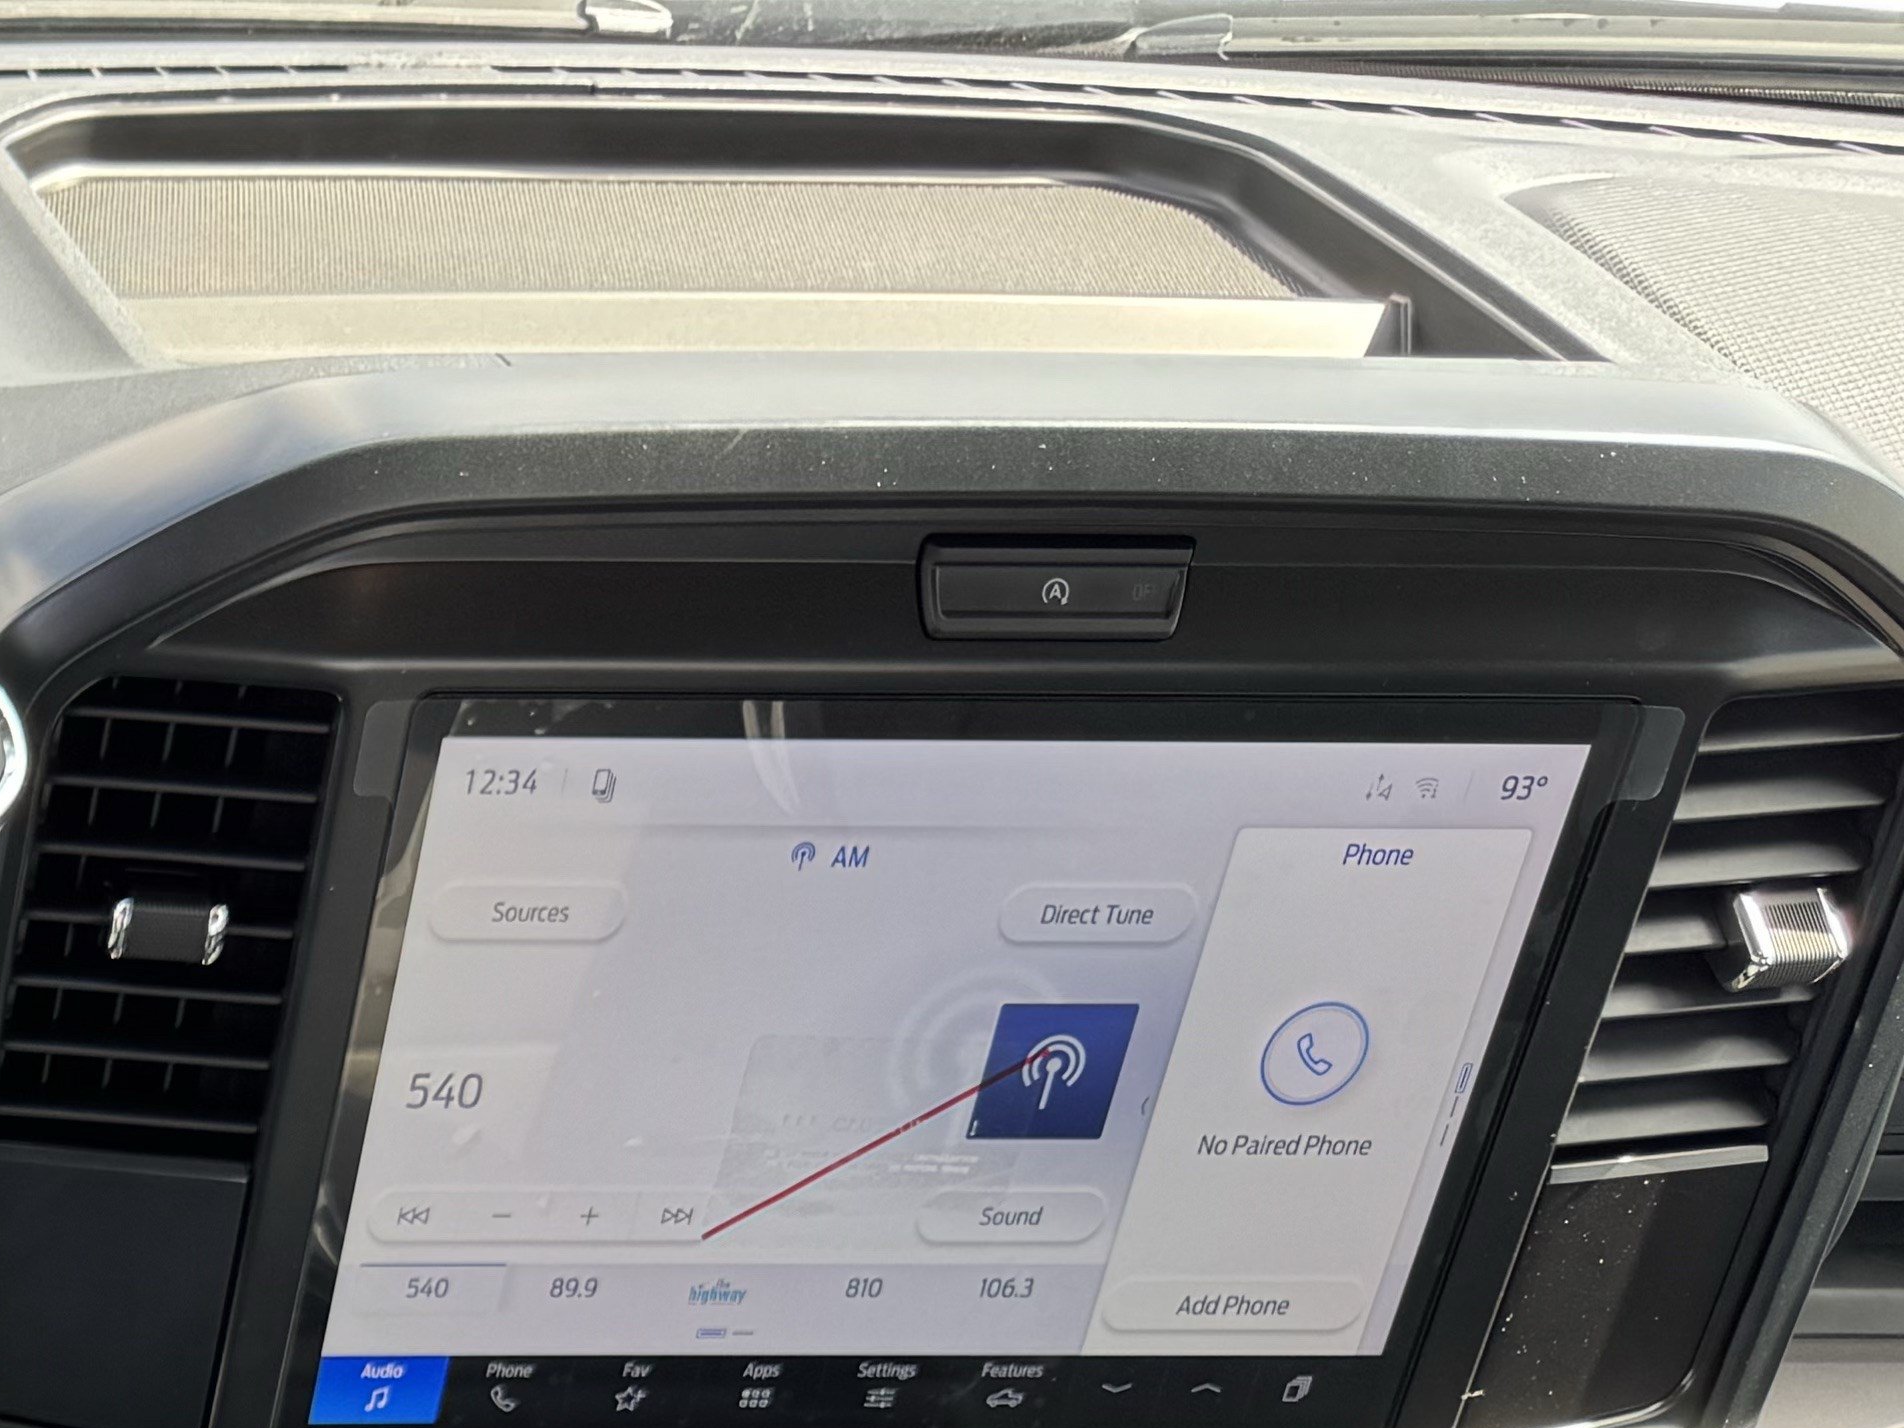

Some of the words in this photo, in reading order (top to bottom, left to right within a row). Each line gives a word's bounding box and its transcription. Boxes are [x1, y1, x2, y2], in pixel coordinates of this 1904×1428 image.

[465, 768, 538, 796] 12:34
[1500, 775, 1549, 801] 93°
[830, 845, 870, 869] AM
[1342, 844, 1414, 867] Phone
[491, 902, 570, 923] Sources
[1040, 904, 1099, 926] Direct
[1104, 904, 1154, 926] Tune
[405, 1073, 484, 1110] 540
[1196, 1134, 1228, 1156] No
[1231, 1134, 1298, 1156] Paired
[1302, 1135, 1373, 1157] Phone
[979, 1206, 1044, 1227] Sound
[405, 1278, 450, 1299] 540
[549, 1278, 598, 1299] 89.9
[688, 1286, 747, 1305] highway
[845, 1278, 883, 1298] 810
[979, 1278, 1034, 1299] 106.3
[1176, 1296, 1218, 1315] Add
[1223, 1296, 1290, 1316] Phone
[360, 1362, 404, 1379] Audio
[486, 1363, 533, 1379] Phone
[622, 1362, 651, 1378] Fav
[743, 1362, 782, 1380] Apps
[857, 1362, 918, 1380] Settings
[981, 1362, 1044, 1378] Features
